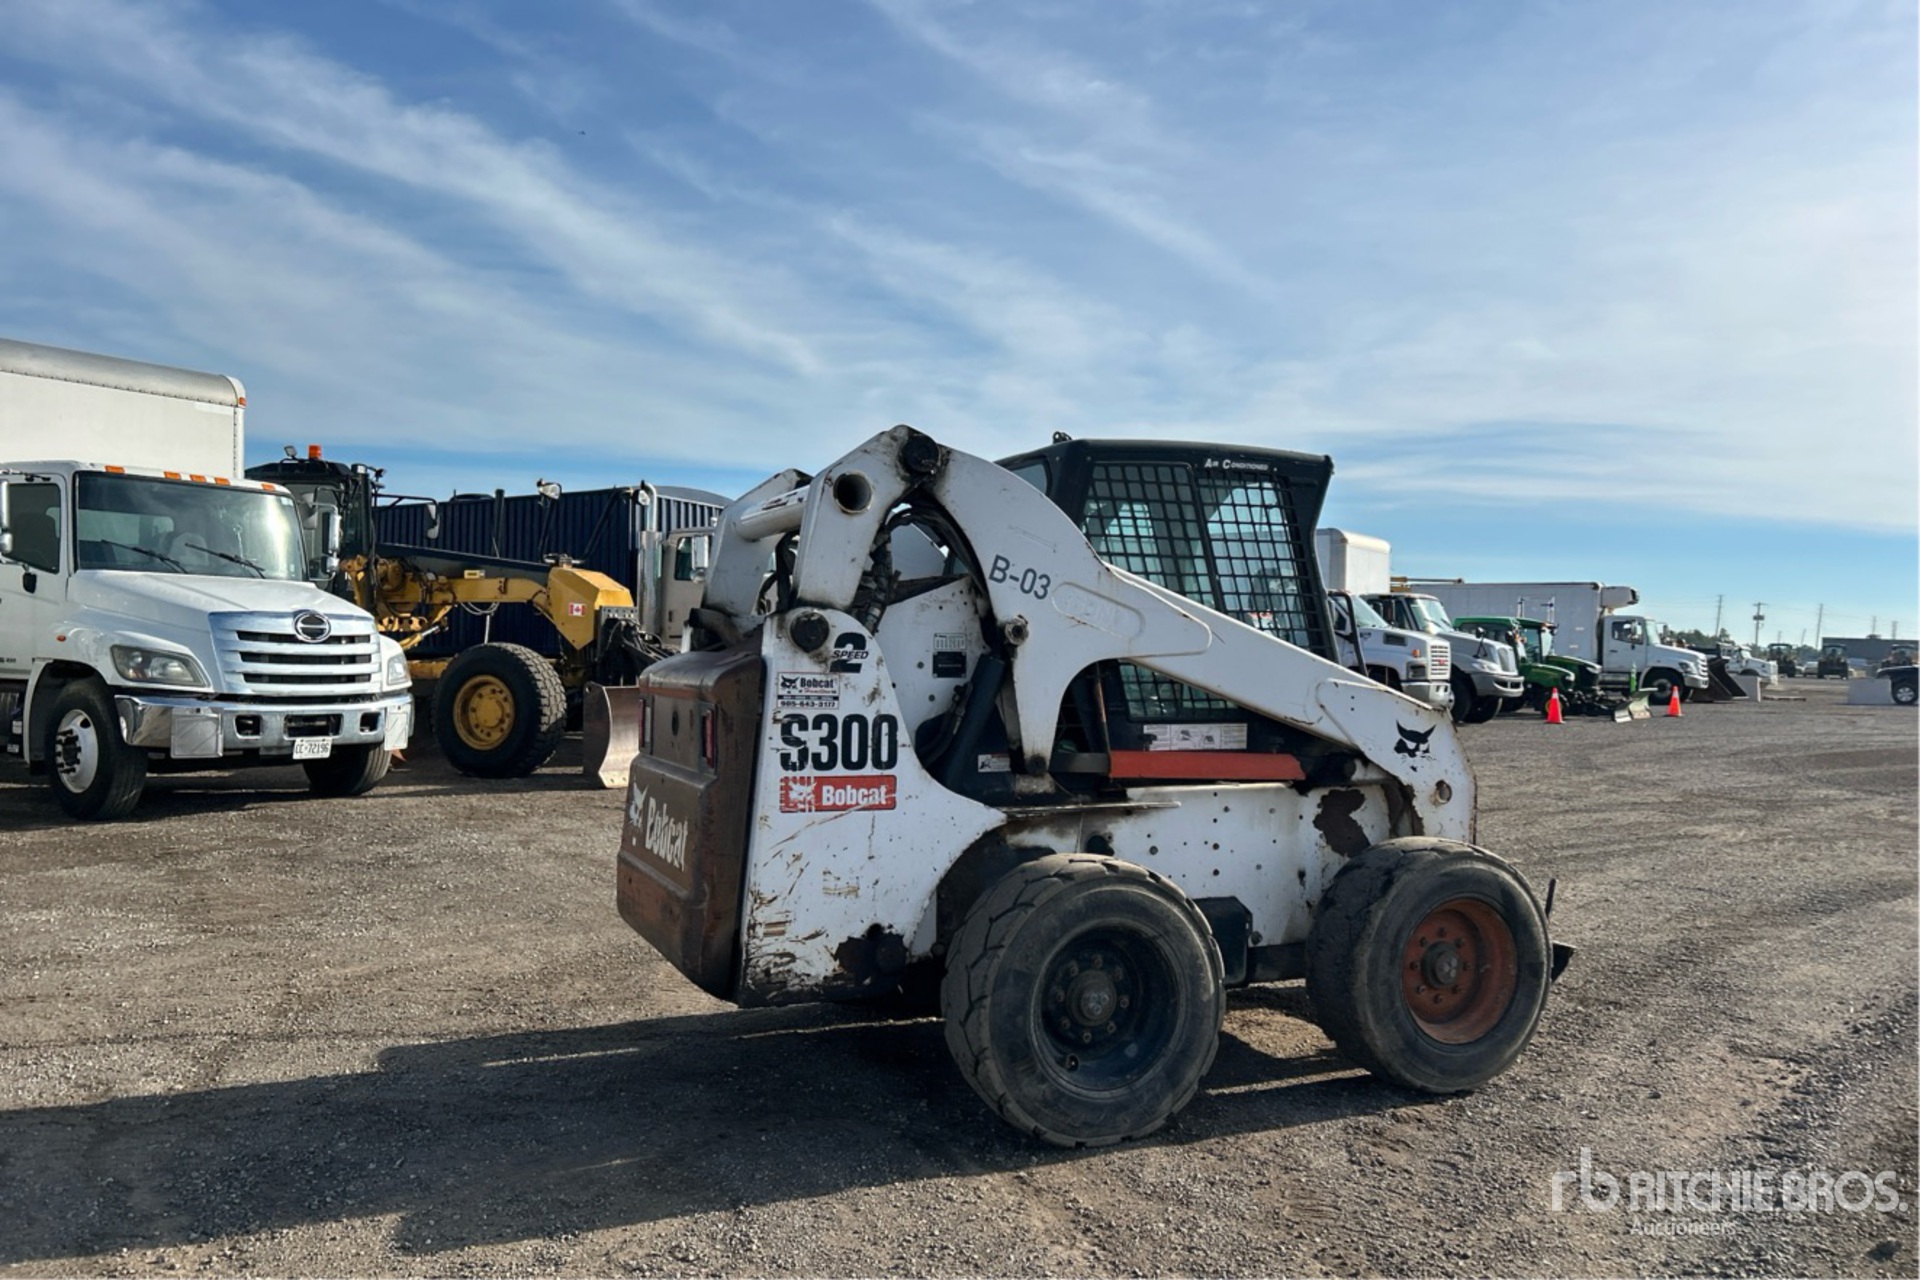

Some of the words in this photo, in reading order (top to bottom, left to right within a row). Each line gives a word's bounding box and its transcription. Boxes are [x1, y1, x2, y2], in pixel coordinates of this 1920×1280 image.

[988, 554, 1051, 600] B-03
[829, 632, 867, 673] 2
[832, 650, 869, 659] SPEED
[800, 677, 834, 688] Bobcat
[780, 713, 898, 771] S300
[822, 784, 887, 806] Bobcat
